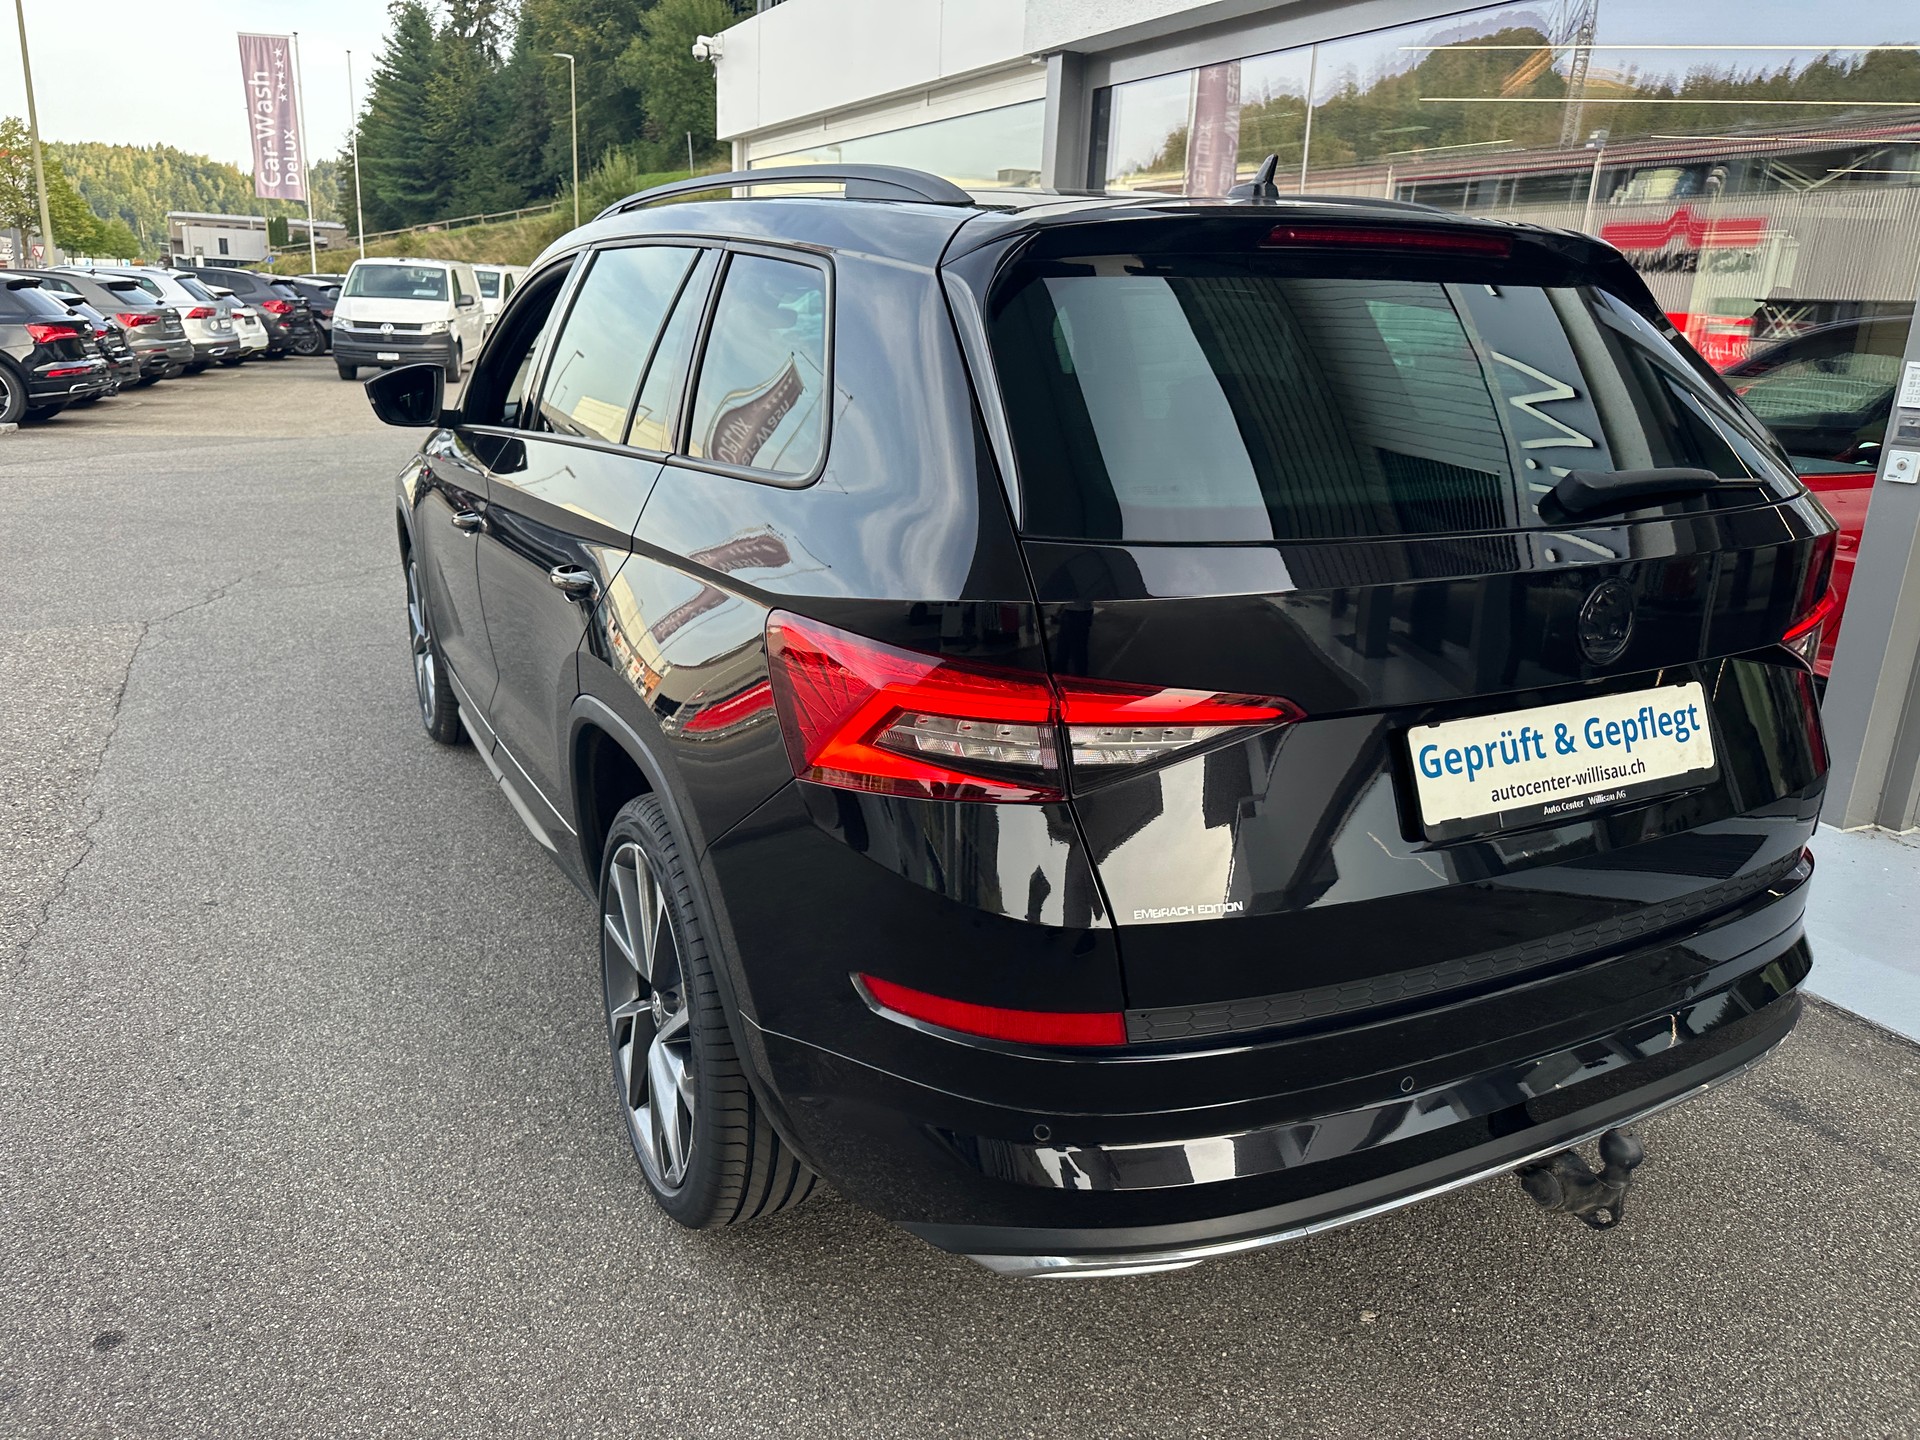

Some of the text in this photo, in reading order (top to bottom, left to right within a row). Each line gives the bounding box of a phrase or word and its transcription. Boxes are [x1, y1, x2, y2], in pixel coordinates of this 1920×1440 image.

[248, 71, 281, 187] Car-Wash
[1419, 703, 1700, 782] Geprüft & Gepflegt
[1491, 758, 1646, 802] autocenter-willisau.ch
[1543, 789, 1626, 815] Auto Center Willisau AG
[1133, 901, 1244, 920] EMBRACH EDITION
